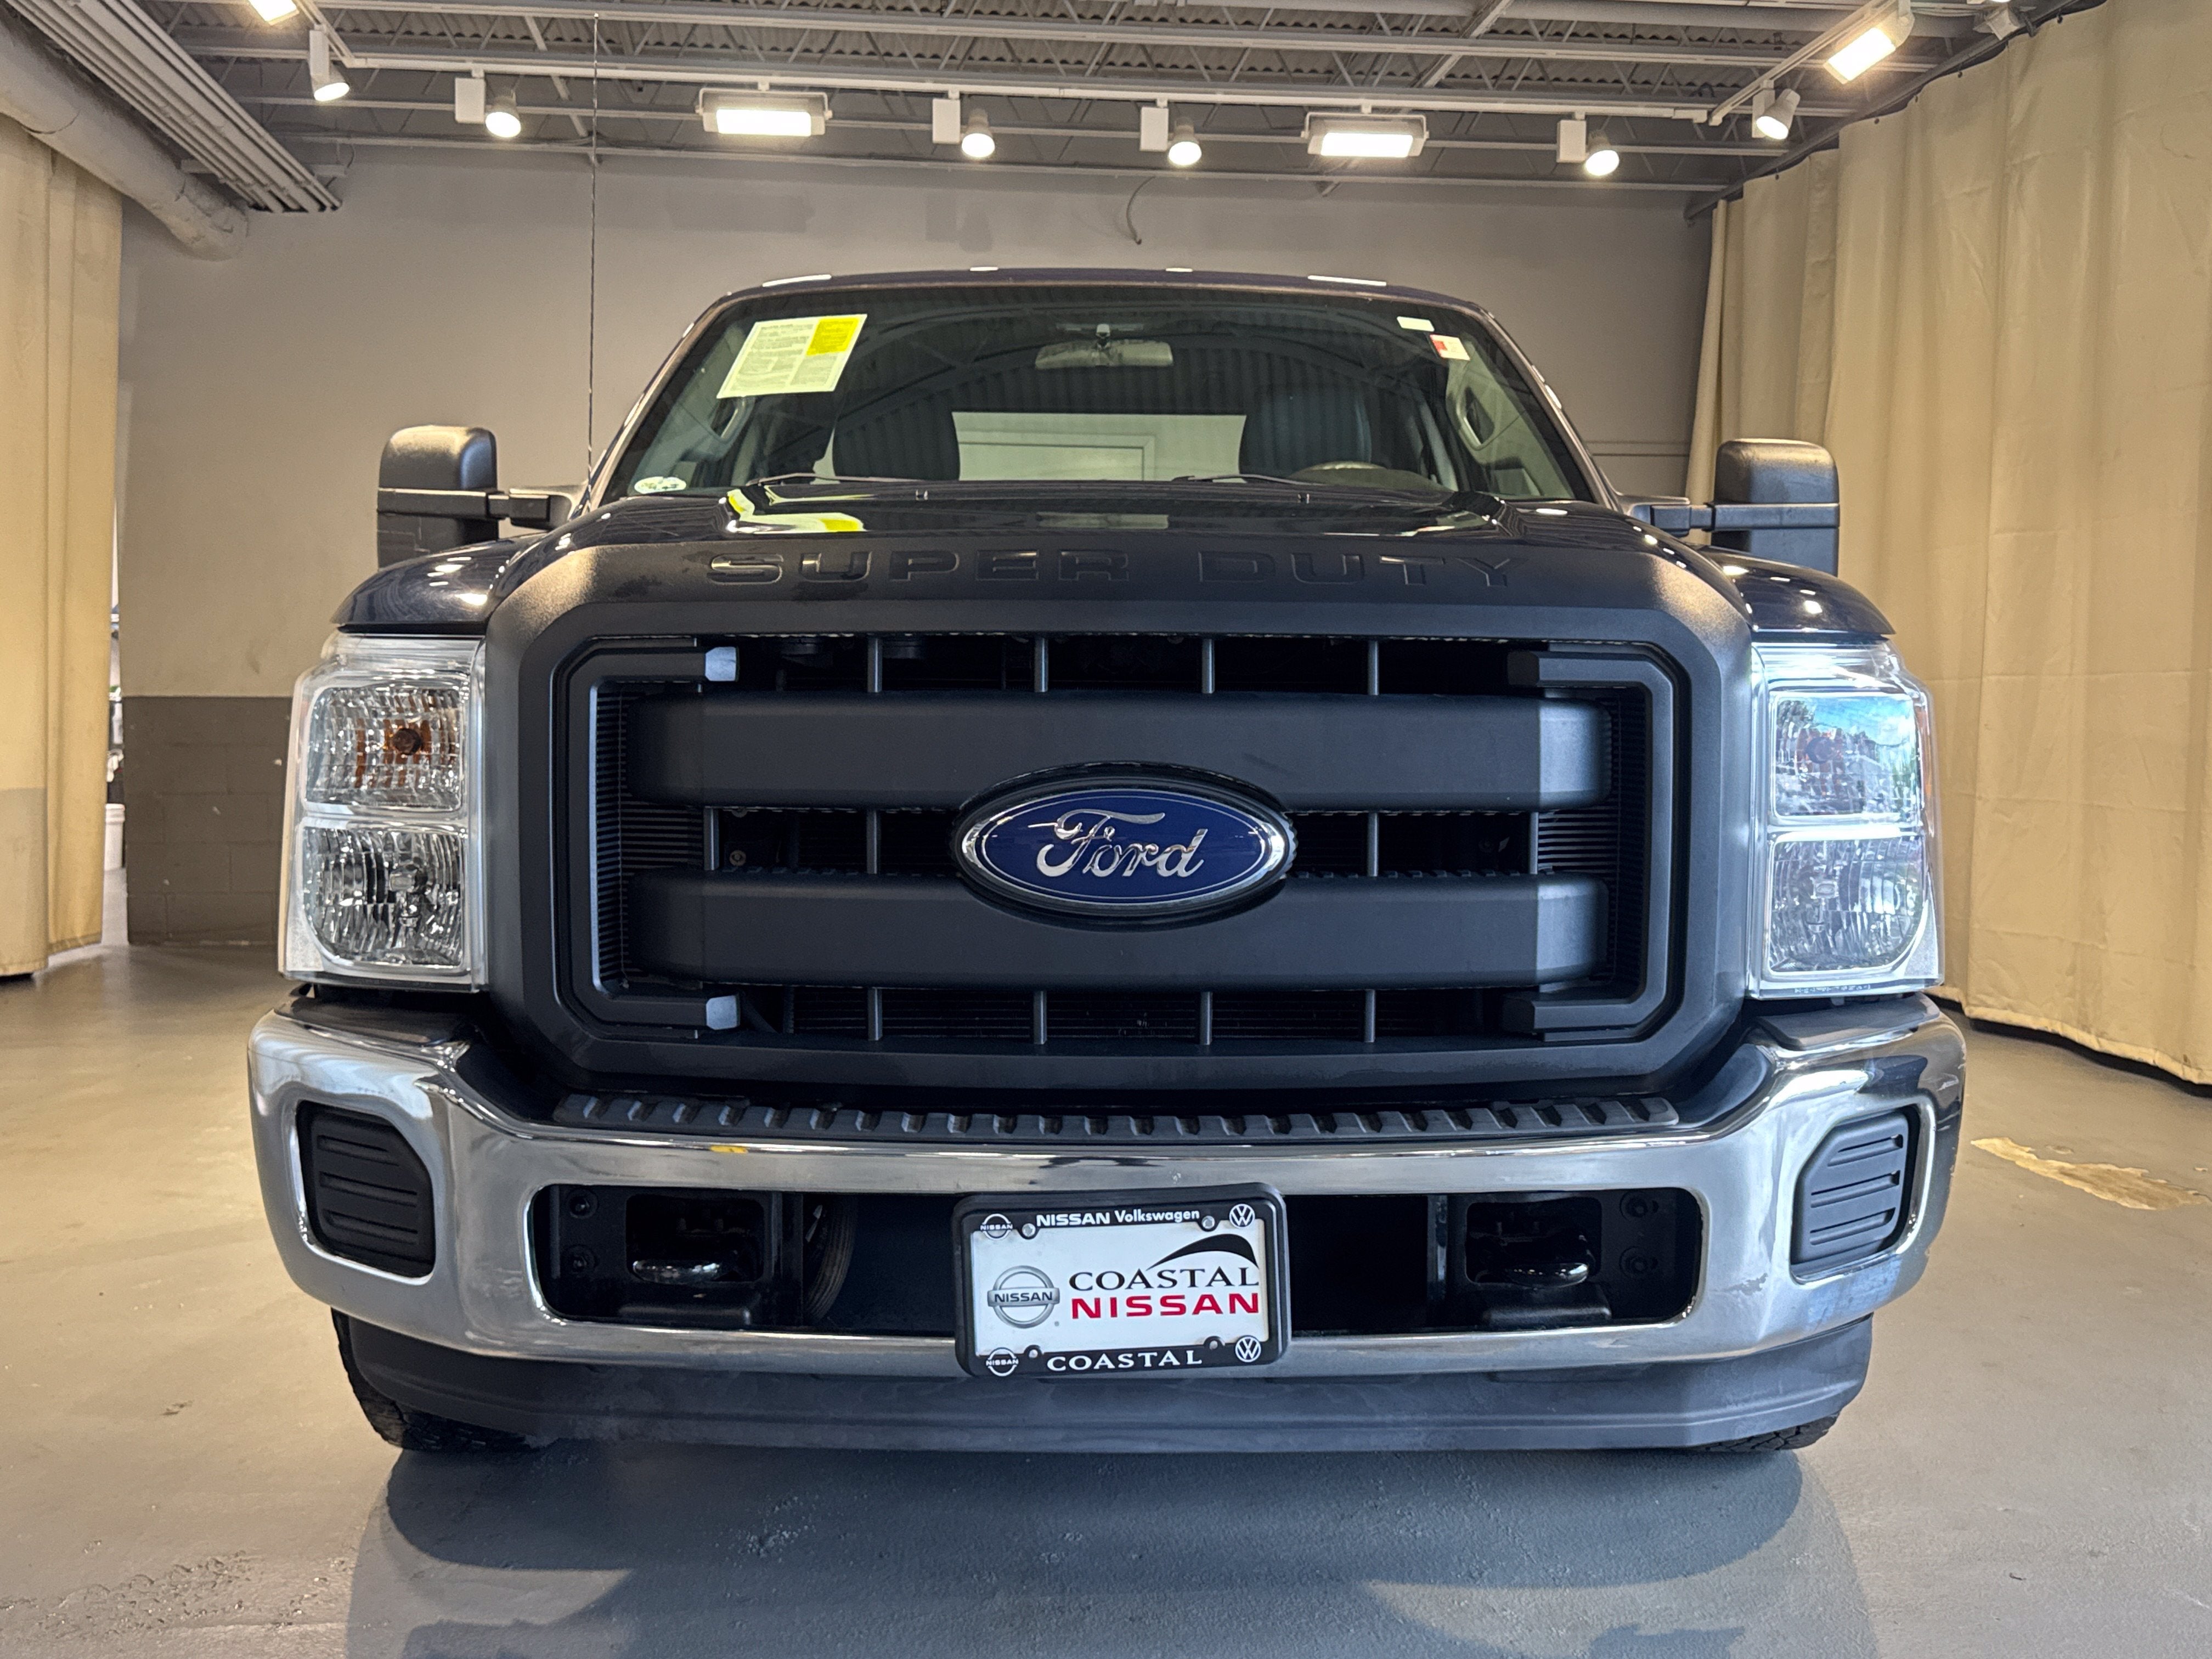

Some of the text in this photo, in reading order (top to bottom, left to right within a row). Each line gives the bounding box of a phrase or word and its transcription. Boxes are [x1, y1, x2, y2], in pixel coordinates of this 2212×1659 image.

[709, 550, 1528, 588] SUPER DUTY
[1028, 809, 1209, 877] Ford
[1036, 1209, 1200, 1227] NISSAN Volkswagen
[1069, 1266, 1260, 1291] COASTAL
[994, 1291, 1053, 1303] NISSAN
[1071, 1293, 1259, 1319] NISSAN
[1046, 1350, 1203, 1372] COASTAL
